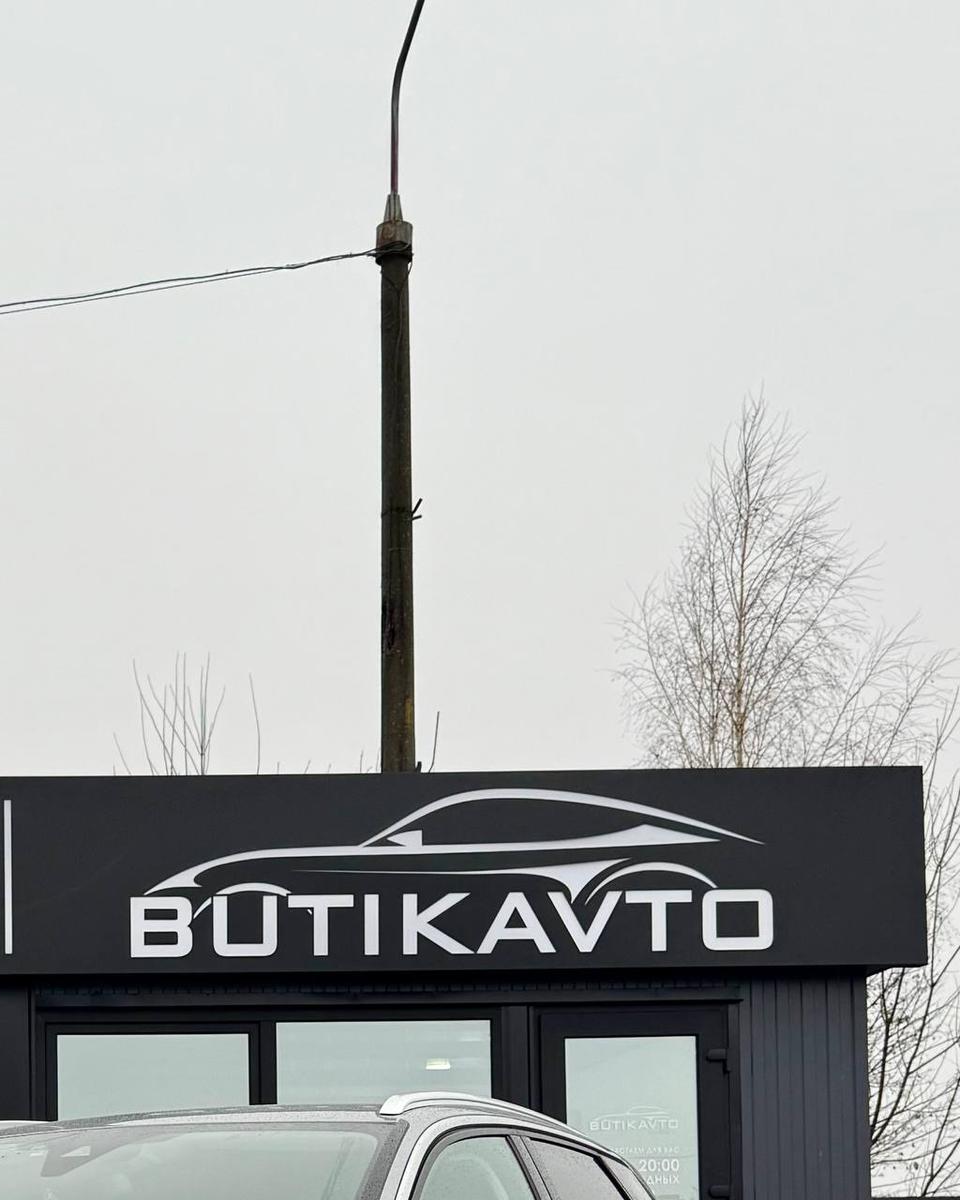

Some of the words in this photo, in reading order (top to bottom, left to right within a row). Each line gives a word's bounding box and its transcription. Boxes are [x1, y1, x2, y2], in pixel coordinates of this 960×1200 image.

[129, 888, 775, 958] BUTIKAVTO
[590, 1119, 679, 1131] BUTIKAVTO
[638, 1159, 680, 1172] 20:00
